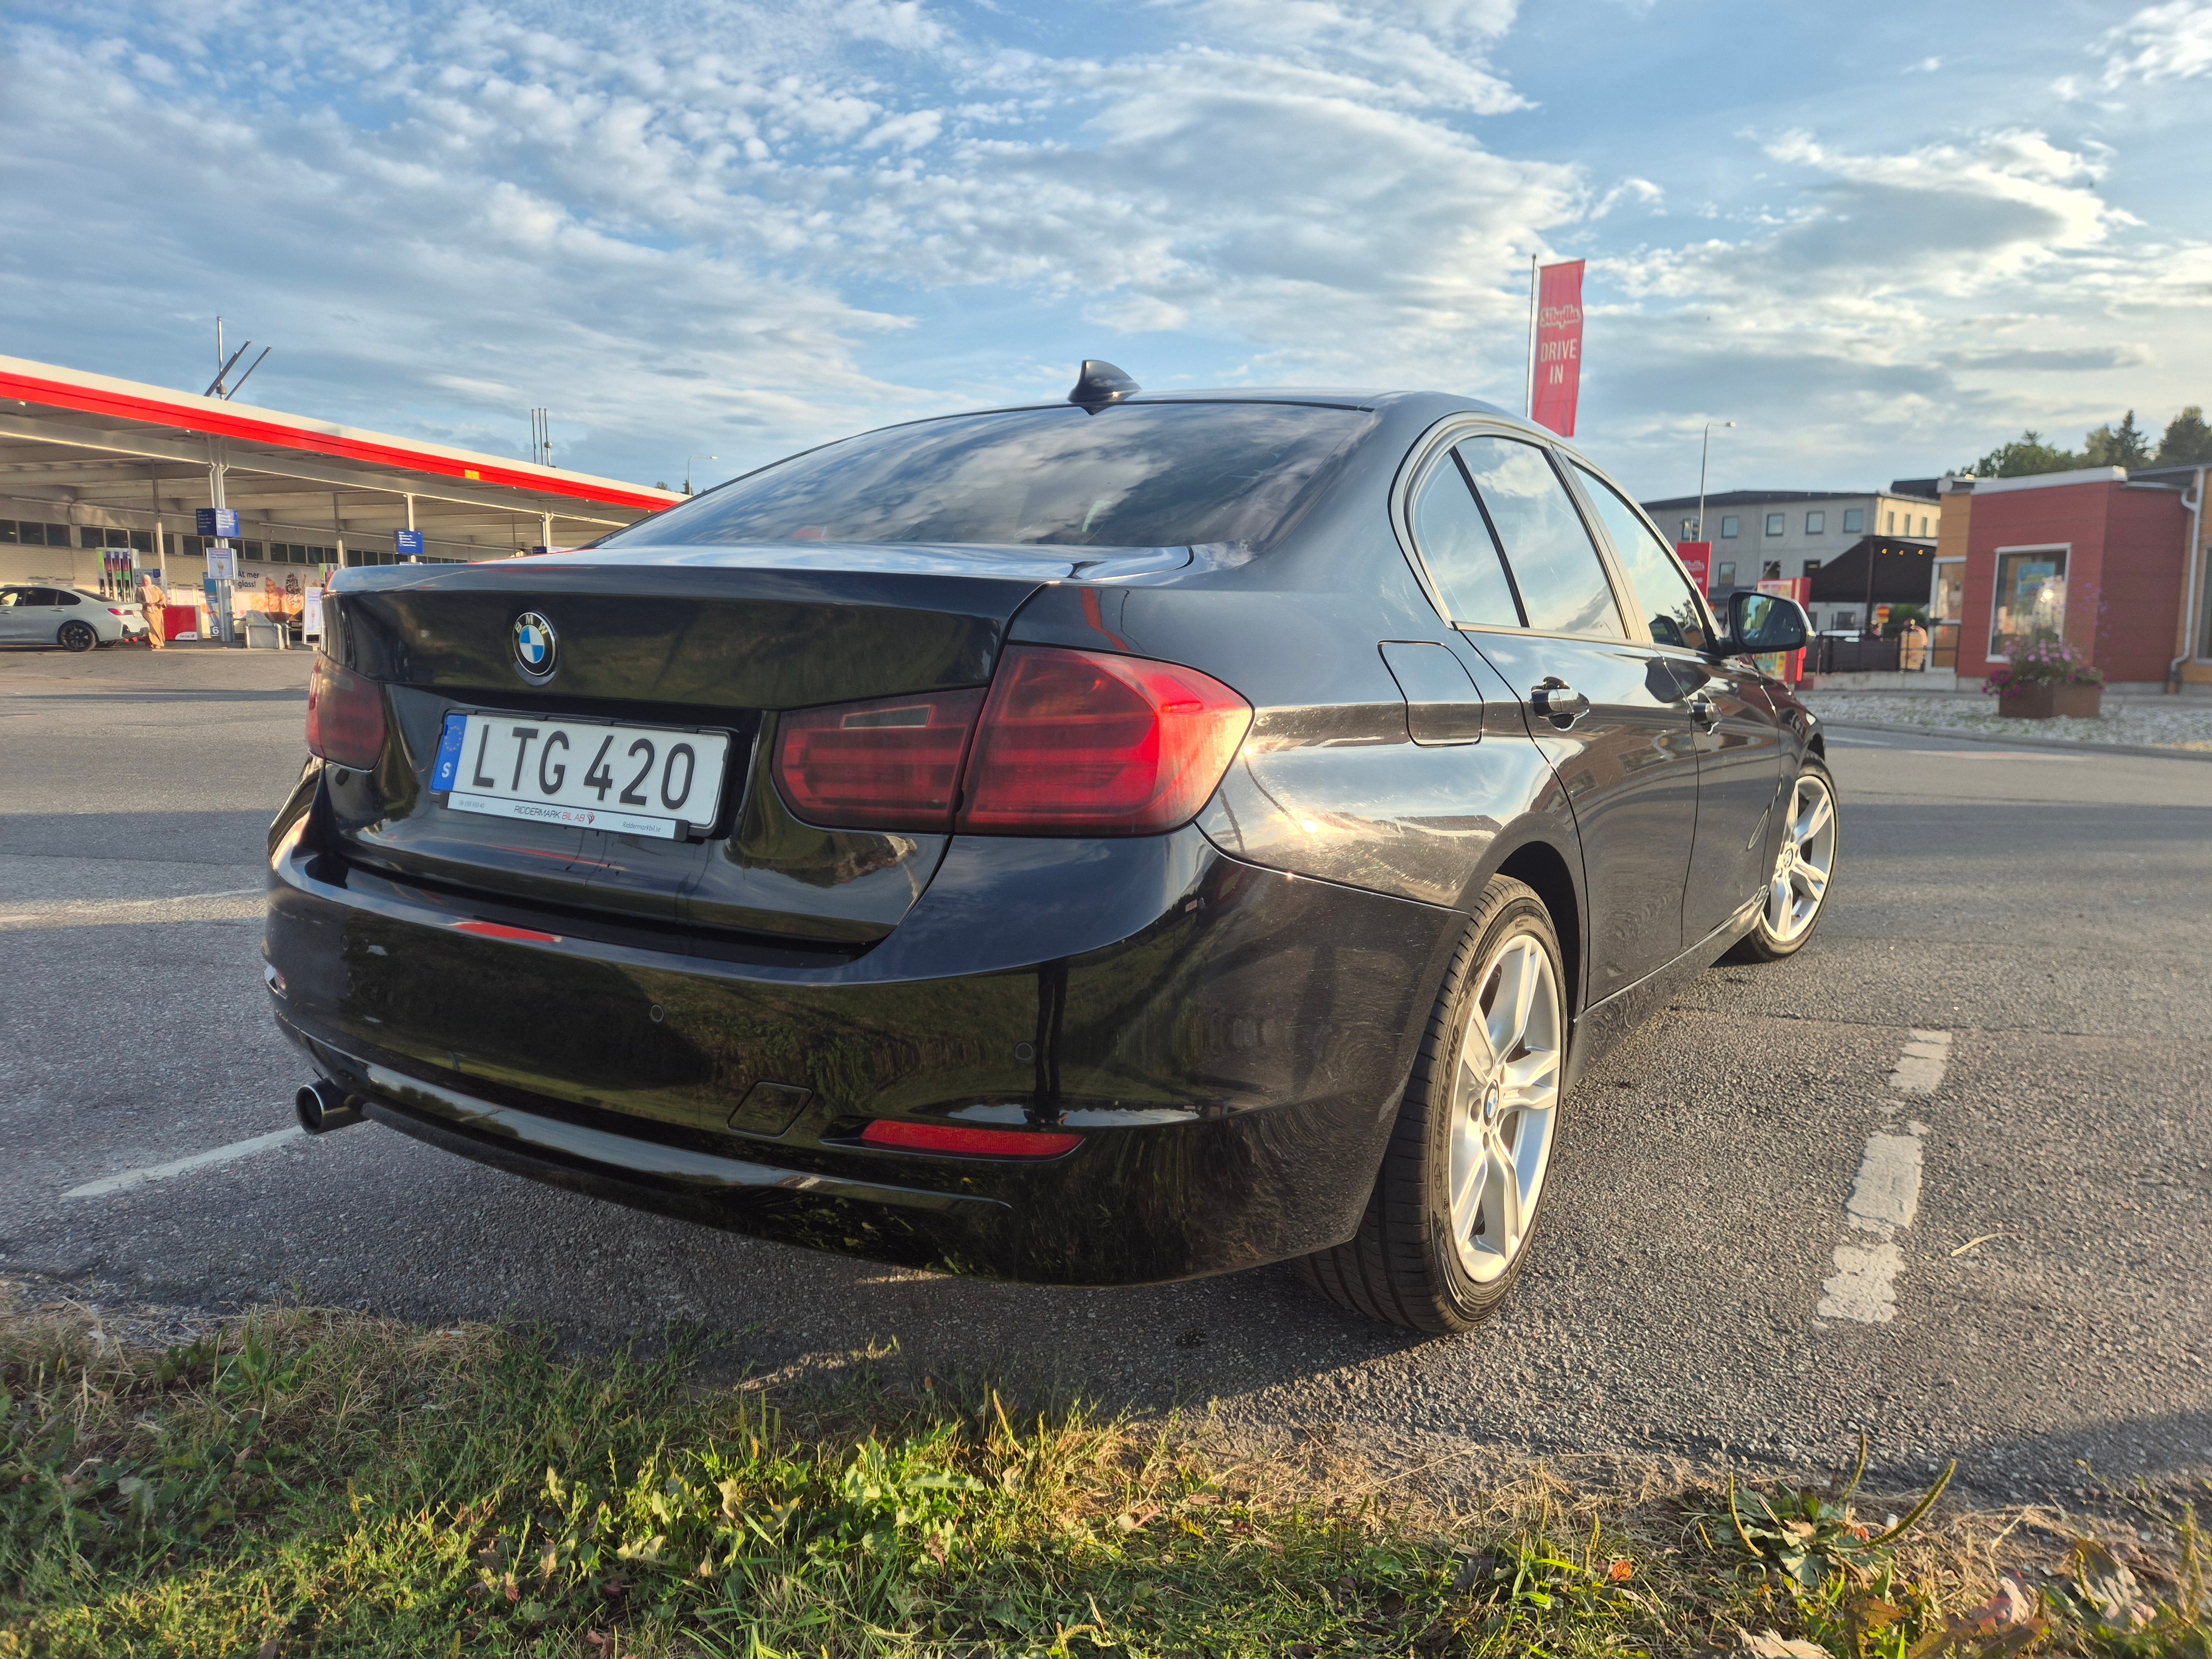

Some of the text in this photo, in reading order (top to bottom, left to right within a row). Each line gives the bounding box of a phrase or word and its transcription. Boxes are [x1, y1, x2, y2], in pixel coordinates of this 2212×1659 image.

[1540, 305, 1580, 328] Sibylla
[1540, 338, 1577, 362] DRIVE
[1549, 364, 1563, 385] IN
[238, 580, 255, 589] glass!
[212, 627, 219, 635] 6
[515, 614, 548, 634] BMW
[441, 762, 451, 779] S
[472, 724, 696, 810] LTG 420
[513, 805, 585, 822] RIDDERMARK BIL AB
[622, 821, 661, 832] Riddermarkbil.se
[1435, 1025, 1459, 1152] LINGLONG
